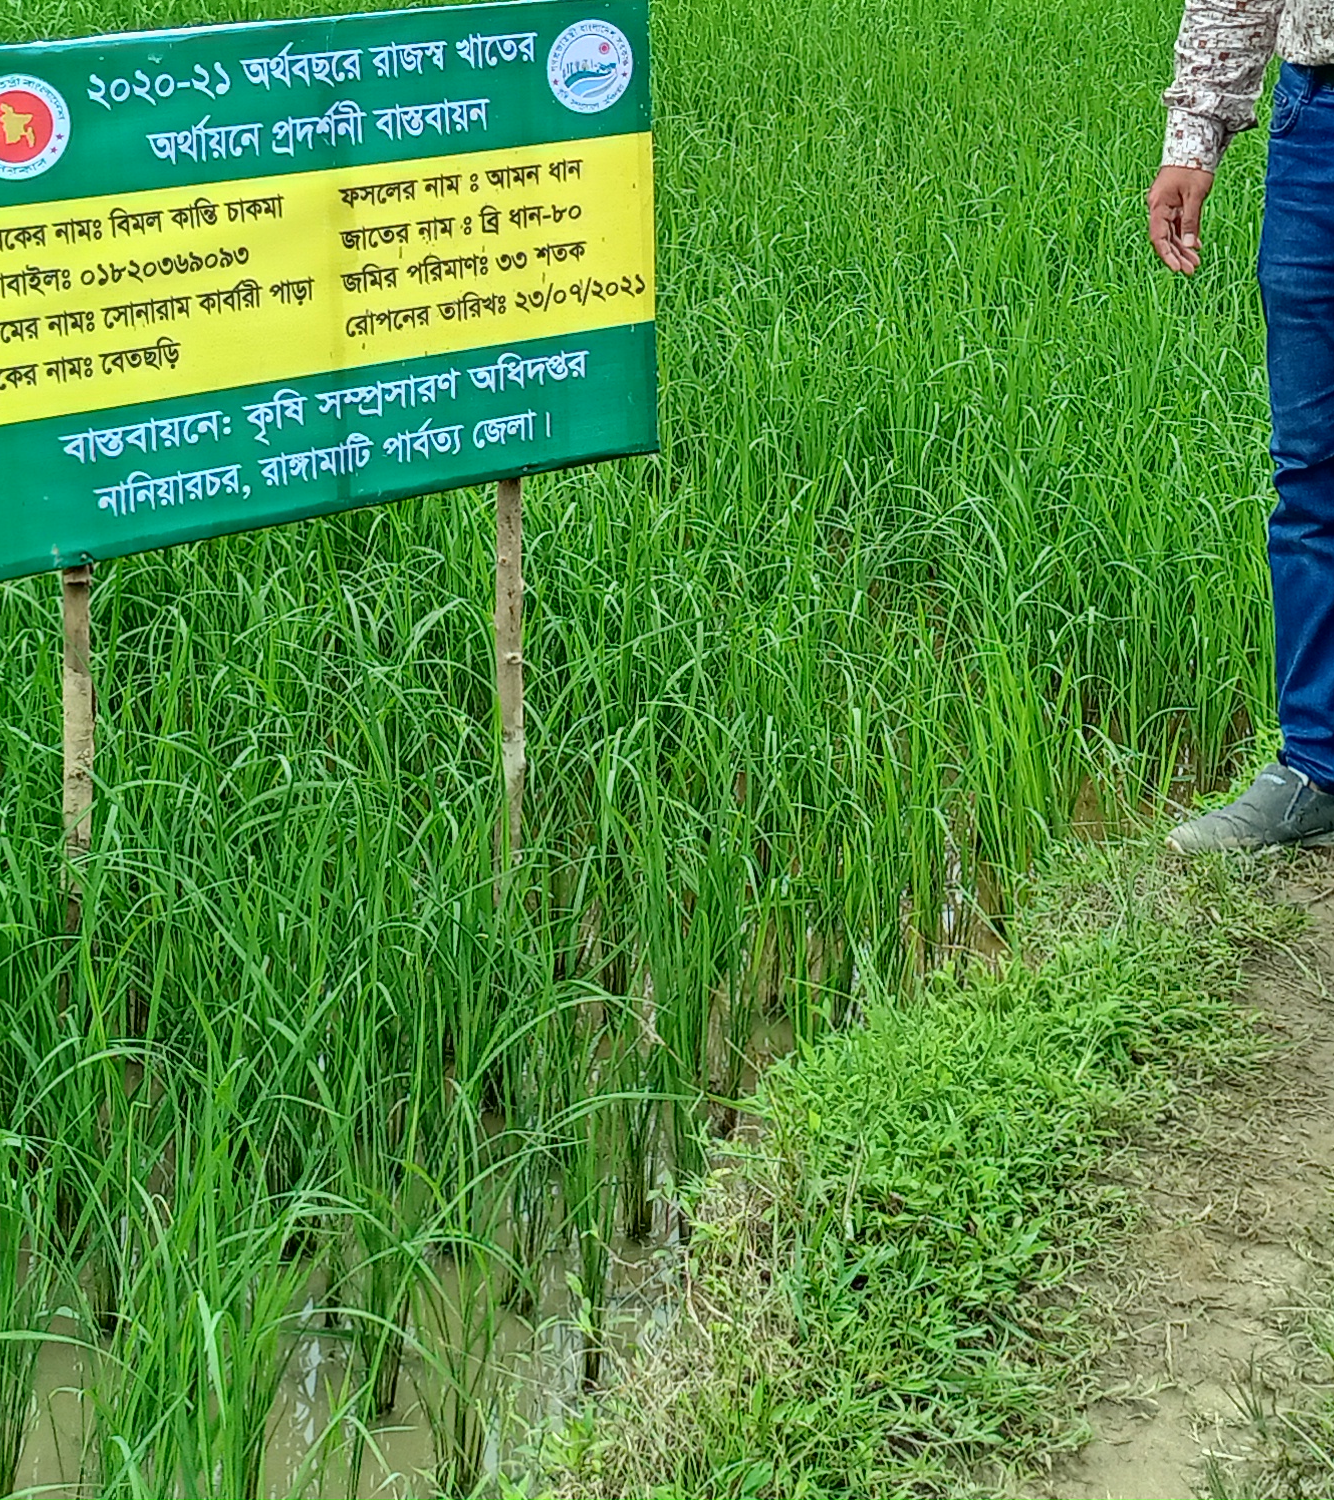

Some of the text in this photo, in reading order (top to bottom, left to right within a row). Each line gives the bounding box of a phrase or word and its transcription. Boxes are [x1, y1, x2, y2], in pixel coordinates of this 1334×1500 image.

[87, 32, 538, 109] ২০২০-২১ অর্থবছরে রাজস্ব খাতের
[146, 98, 490, 164] অর্থায়নে প্রদর্শনী বাস্তবায়ন
[339, 180, 418, 208] ফসলের
[423, 174, 462, 197] নাম
[485, 164, 542, 189] আমন
[548, 159, 583, 182] ধান
[108, 207, 164, 238] বিমল
[169, 197, 220, 229] কান্তি
[224, 194, 284, 223] চাকমা
[339, 223, 410, 251] জাতের
[416, 217, 456, 241] নাম
[478, 205, 502, 235] ব্রি
[509, 204, 582, 229] ধান-৮০
[80, 247, 249, 287] ০১৮২০৩৬৯০৯৩
[340, 263, 399, 294] জমির
[495, 251, 528, 272] ৩৩
[534, 241, 587, 266] শতক
[101, 296, 192, 329] সোনারাম
[197, 278, 263, 314] কার্বারী
[270, 276, 315, 306] পাড়া
[345, 305, 431, 338] রোপনের
[514, 273, 646, 313] ২৩/০৭/২০২১
[99, 336, 181, 375] বেতছড়ি
[243, 388, 307, 445] কৃষি
[315, 367, 461, 418] সম্প্রসারণ
[467, 349, 589, 393] অধিদপ্তর
[94, 463, 252, 516] নানিয়ারচর,
[258, 432, 374, 487] রাঙ্গামাটি
[382, 417, 465, 462] পার্বত্য
